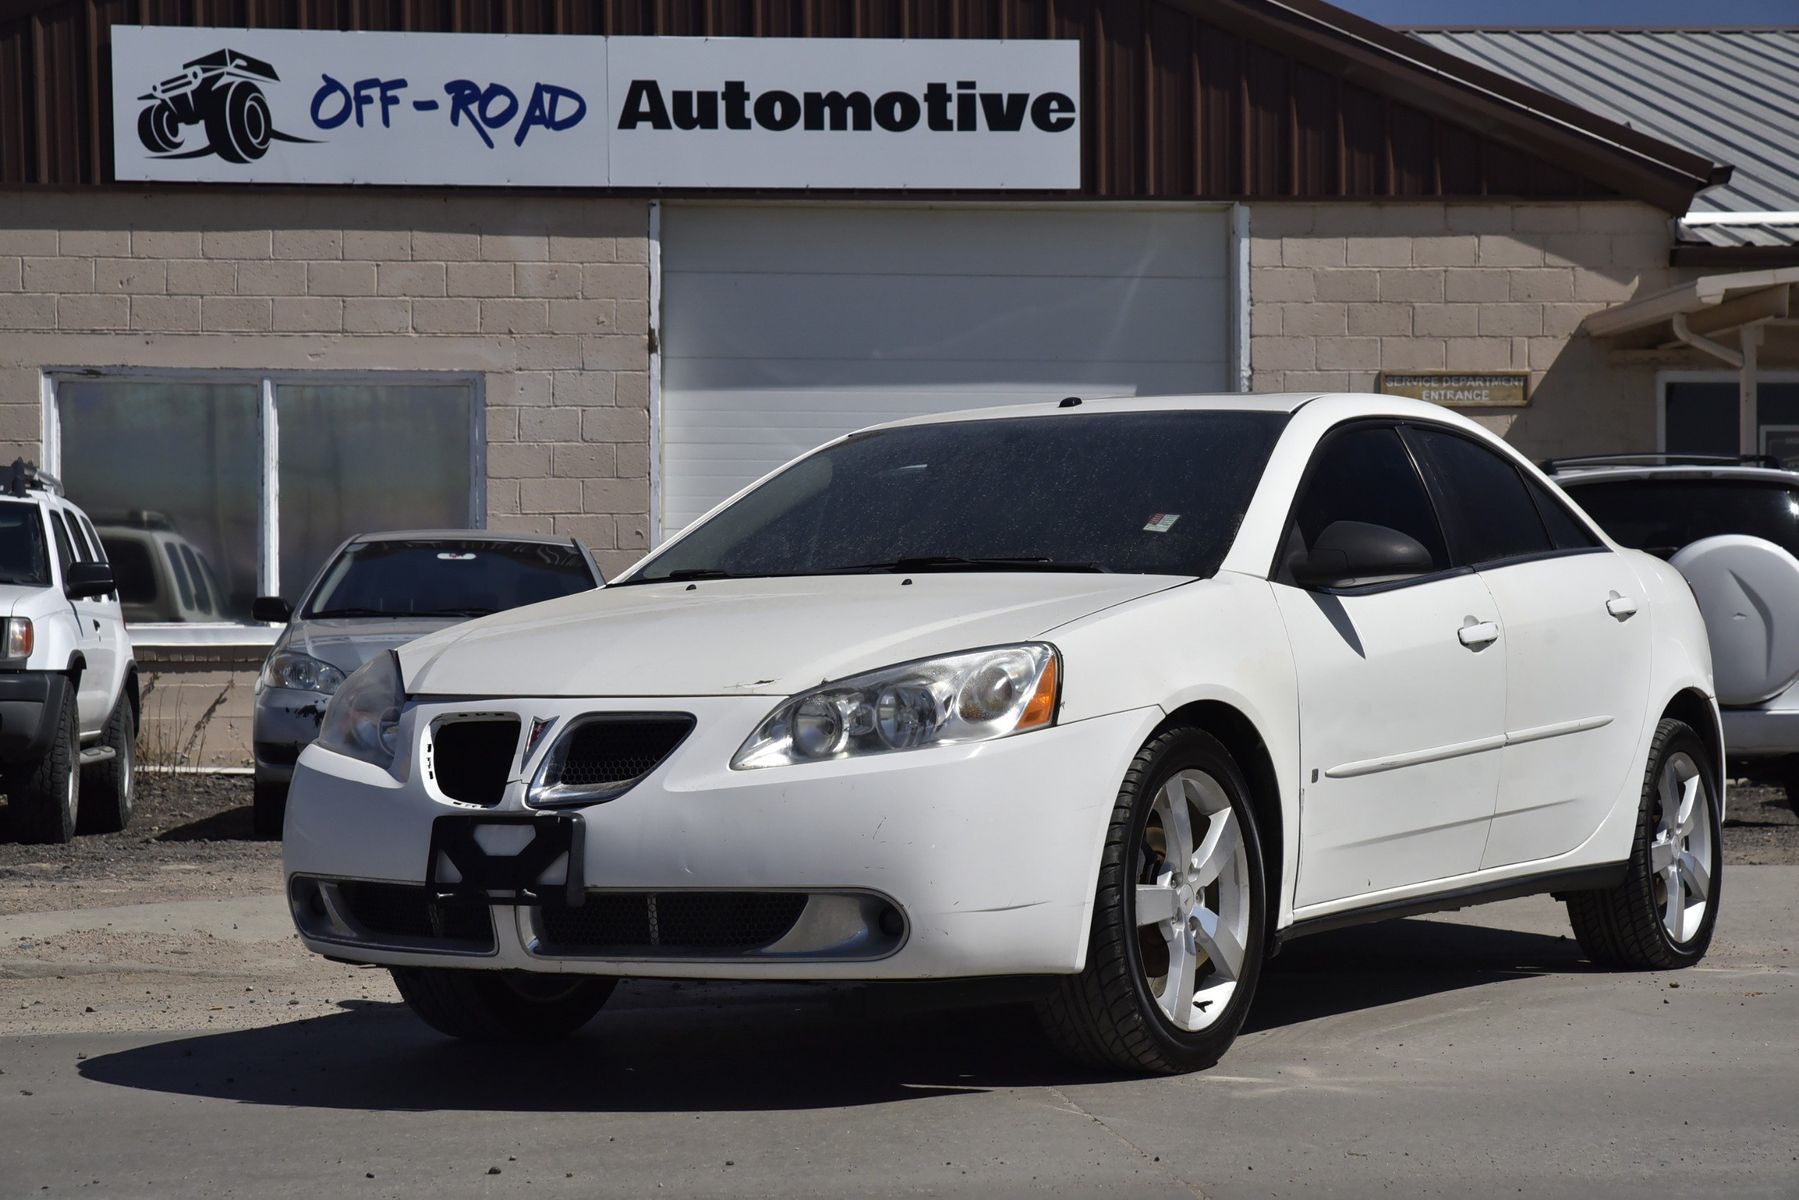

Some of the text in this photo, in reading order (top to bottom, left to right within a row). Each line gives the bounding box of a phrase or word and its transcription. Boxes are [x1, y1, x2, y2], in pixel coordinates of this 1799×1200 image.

[310, 74, 1076, 149] OFF-ROAD Automotive
[1385, 375, 1524, 387] SERVICE DEPARTMENT
[1422, 389, 1489, 401] ENTRANCE
